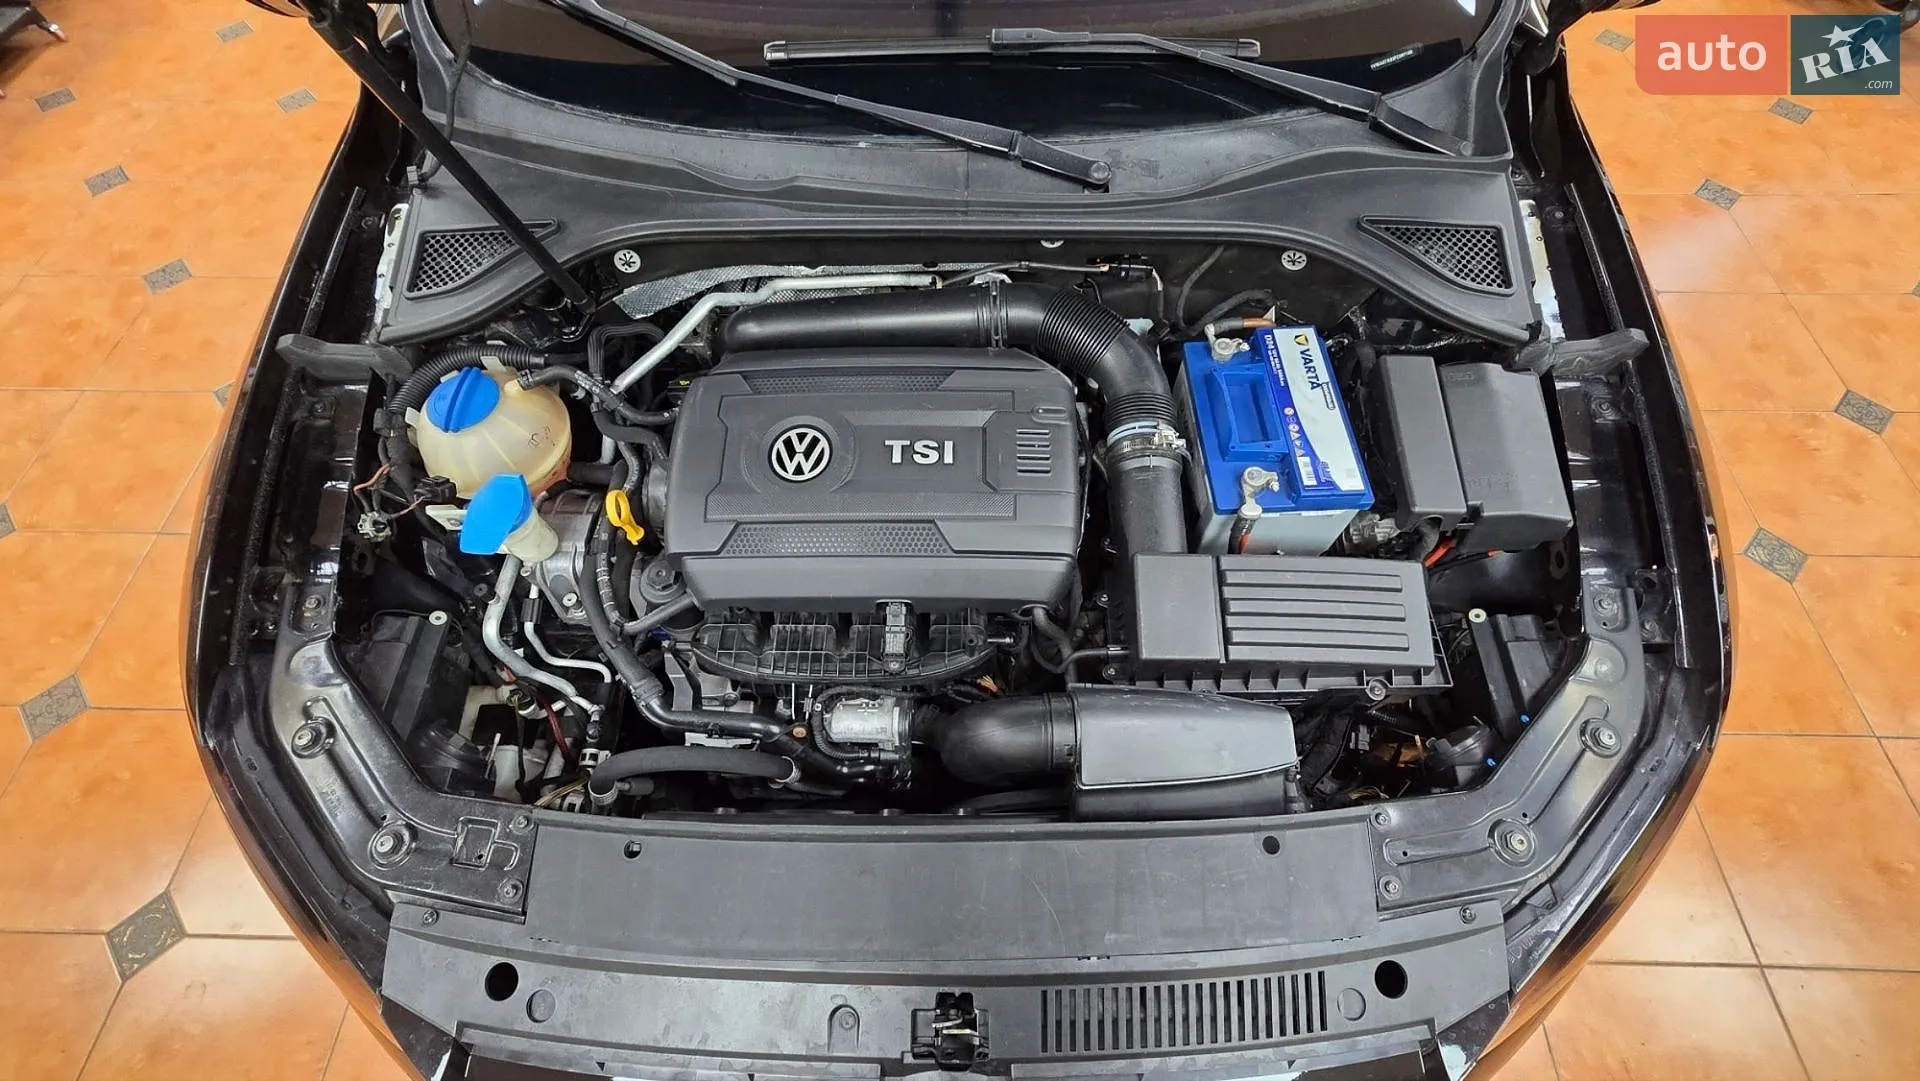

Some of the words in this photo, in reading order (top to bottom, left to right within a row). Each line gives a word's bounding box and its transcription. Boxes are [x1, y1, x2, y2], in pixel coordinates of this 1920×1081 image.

[1300, 348, 1322, 390] VARTA
[770, 427, 831, 481] VW
[884, 439, 954, 465] TSI
